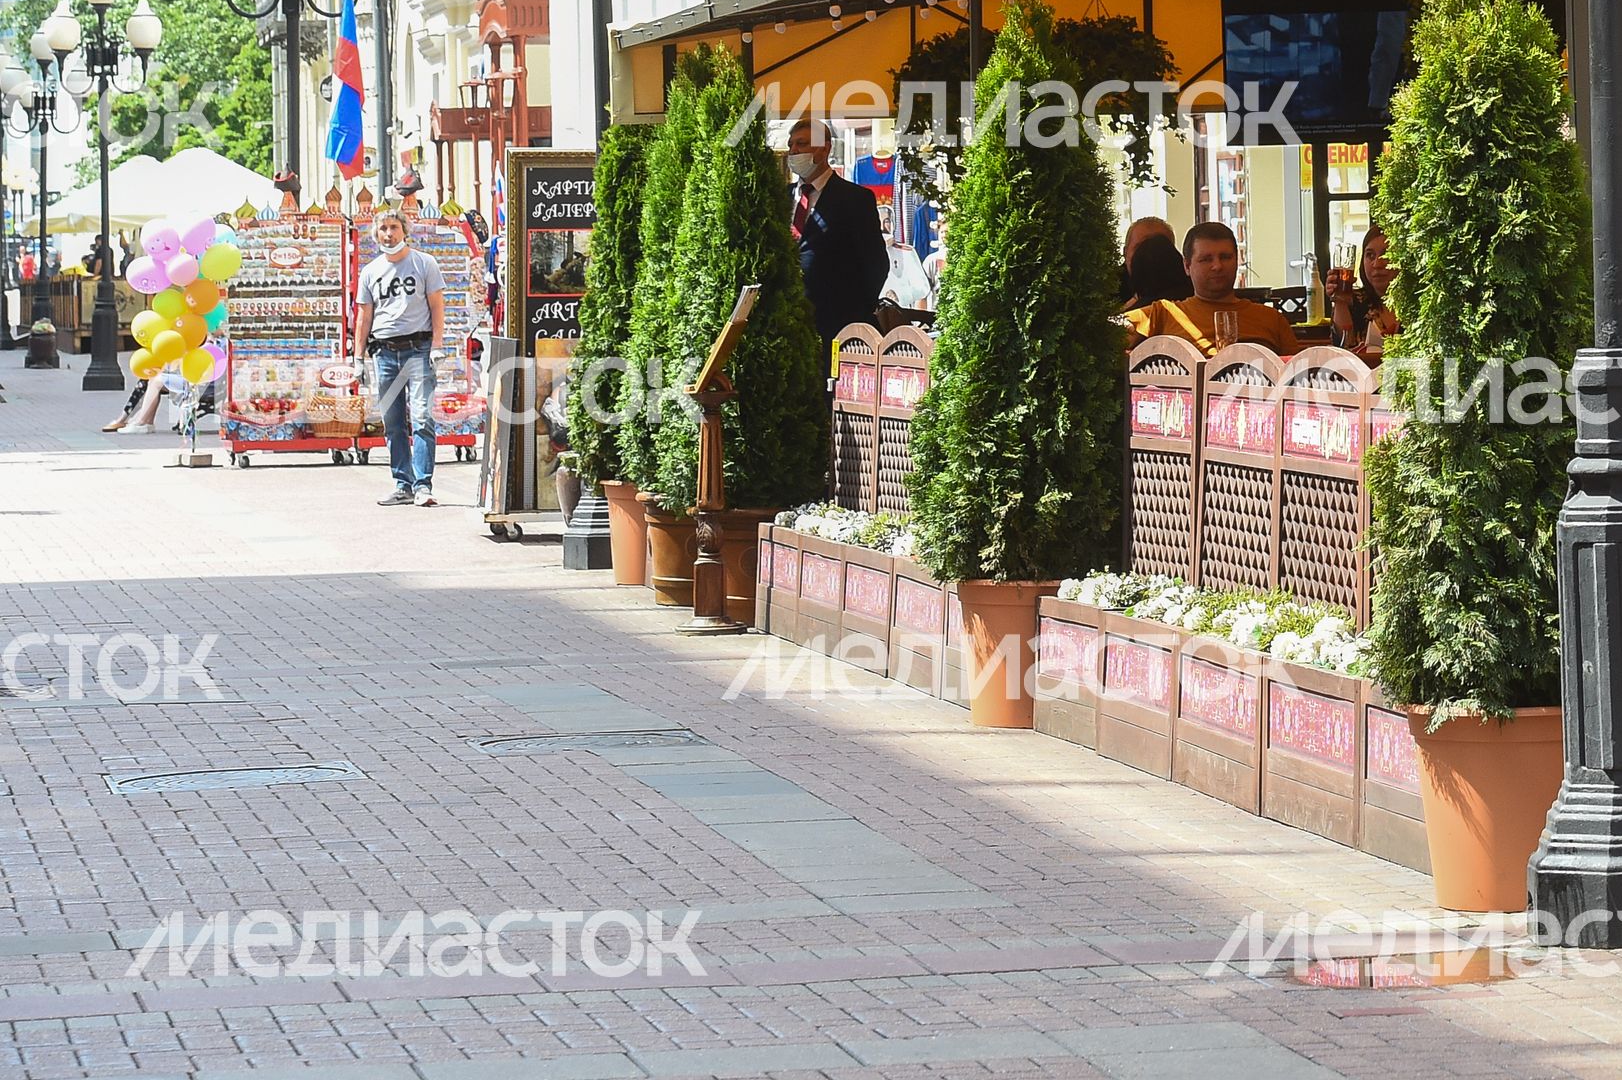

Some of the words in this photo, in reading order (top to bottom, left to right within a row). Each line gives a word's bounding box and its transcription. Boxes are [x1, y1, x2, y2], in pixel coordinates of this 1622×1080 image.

[532, 180, 596, 200] КАРТИ
[376, 275, 417, 300] Lee
[531, 301, 579, 324] ART
